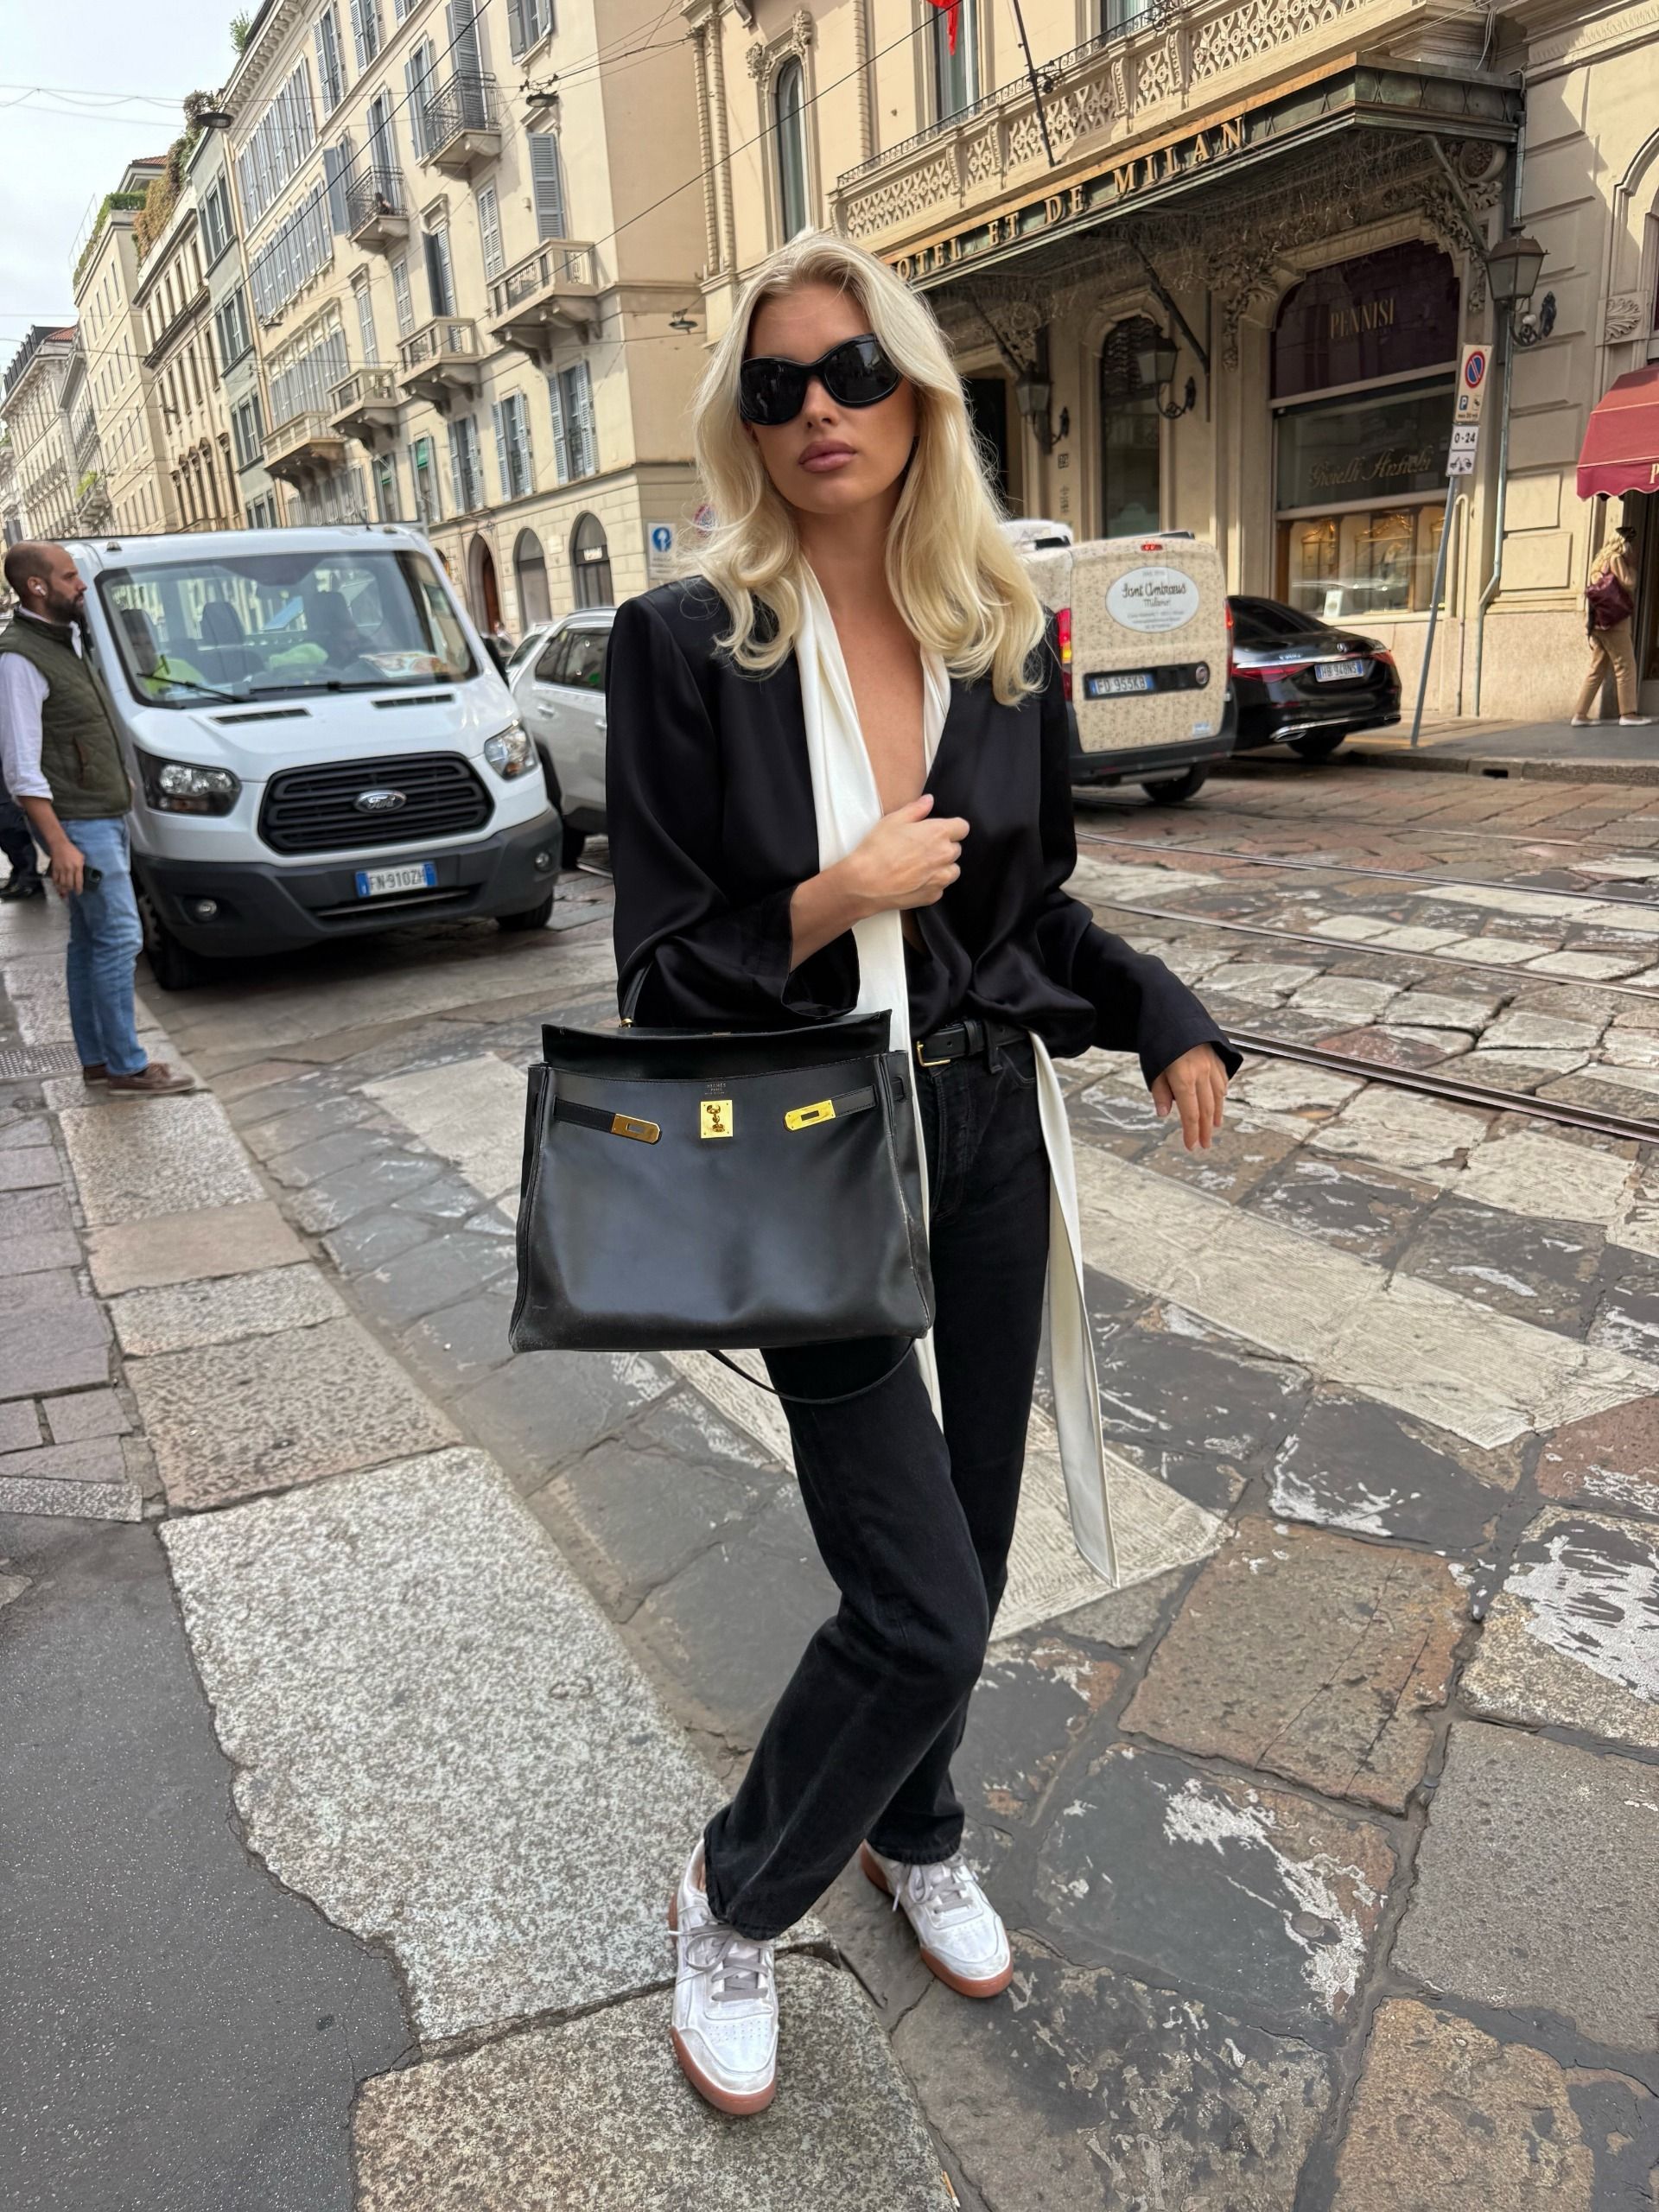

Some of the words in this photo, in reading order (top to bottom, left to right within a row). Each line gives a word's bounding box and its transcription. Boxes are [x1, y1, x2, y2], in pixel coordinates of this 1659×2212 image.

[897, 238, 962, 281] OTEL
[988, 213, 1020, 247] ET
[1044, 185, 1084, 225] DE
[1113, 117, 1243, 197] MILAN
[1331, 297, 1394, 339] PENNISI
[1122, 582, 1143, 598] Sant
[367, 794, 396, 810] Ford
